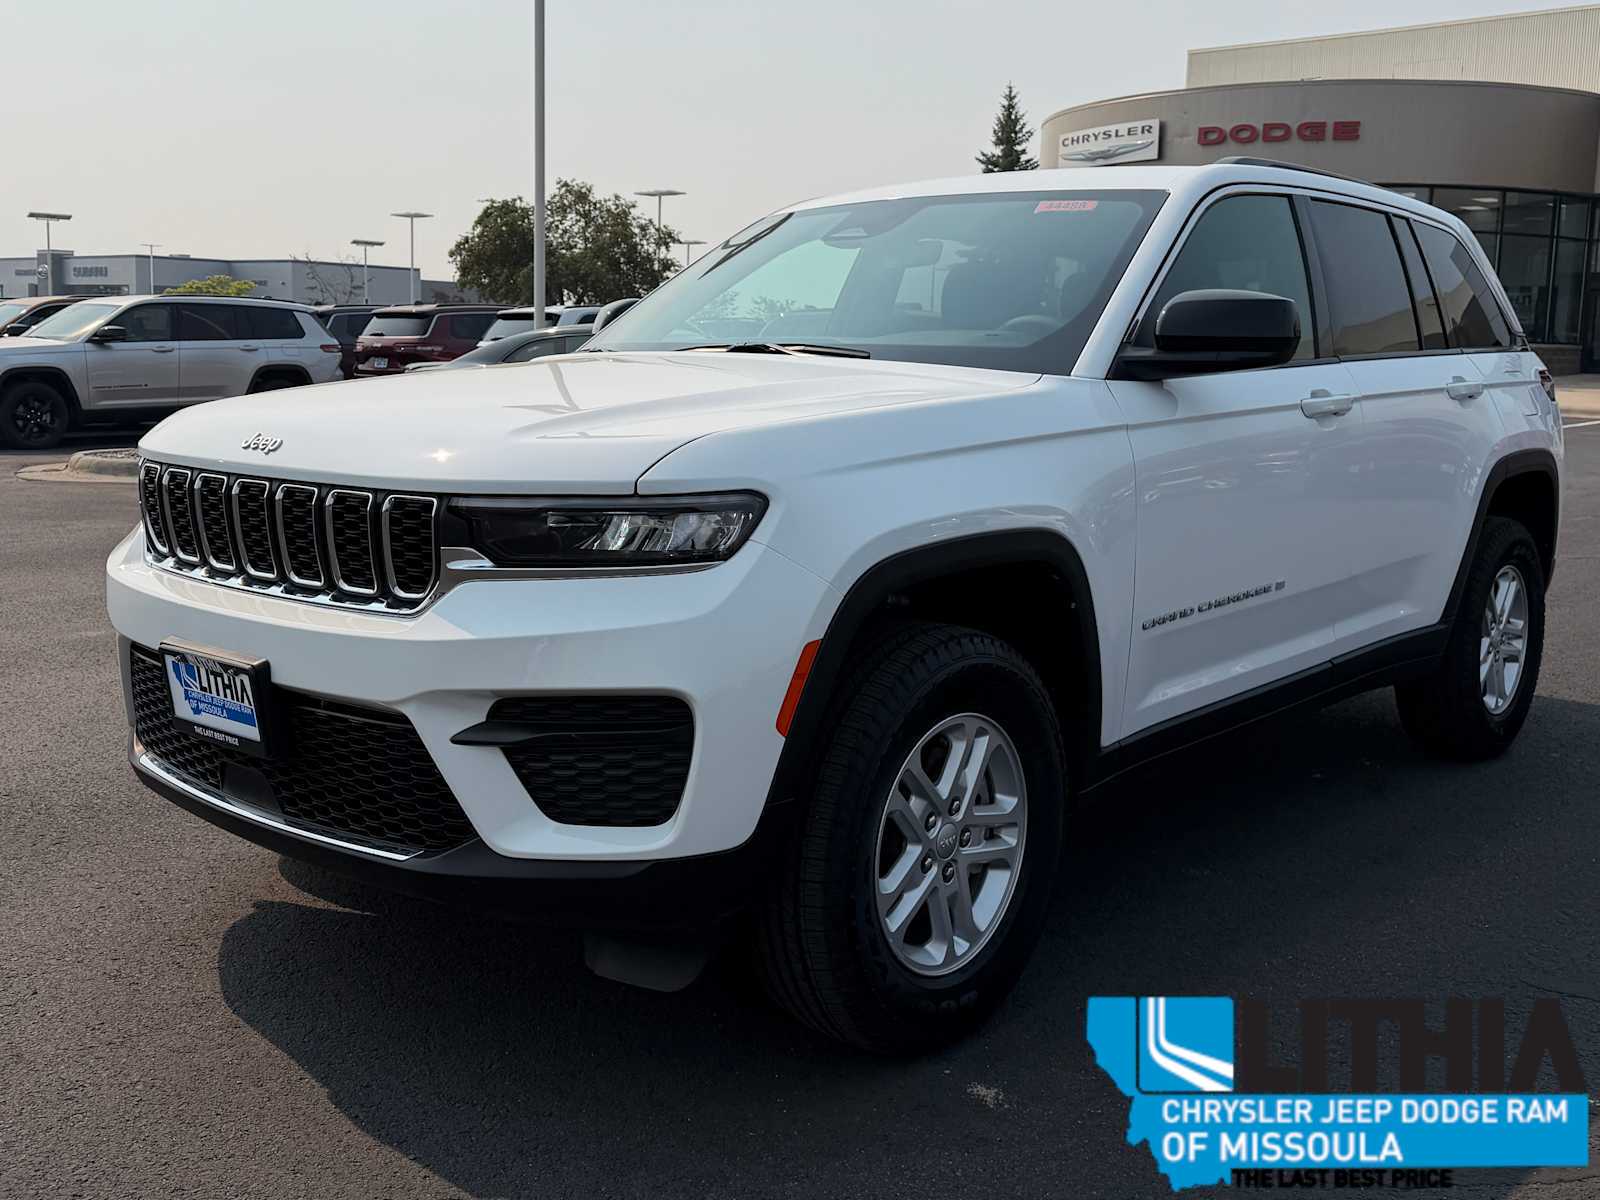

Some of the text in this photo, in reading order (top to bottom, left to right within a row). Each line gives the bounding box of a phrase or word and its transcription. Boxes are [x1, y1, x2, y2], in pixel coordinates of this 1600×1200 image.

[1062, 124, 1153, 147] CHRYSLER
[1197, 121, 1361, 145] DODGE
[241, 432, 283, 455] Jeep
[196, 662, 253, 707] LITHIA
[187, 690, 212, 703] CHRYSLER
[224, 700, 240, 711] DODGE
[189, 699, 228, 718] OF MISSOULA
